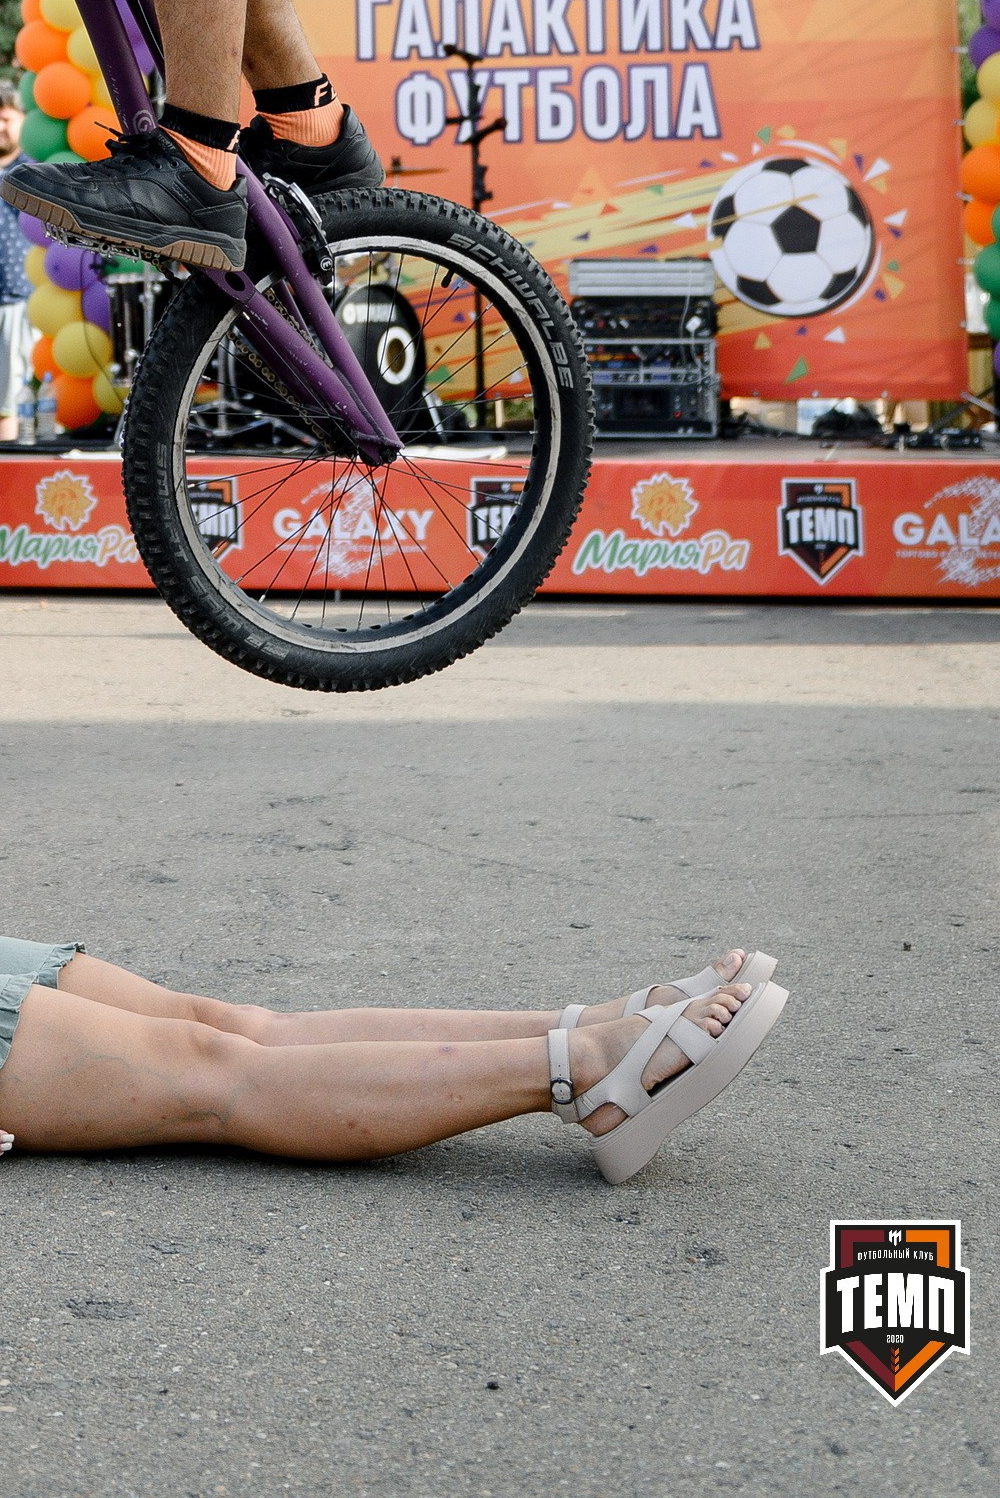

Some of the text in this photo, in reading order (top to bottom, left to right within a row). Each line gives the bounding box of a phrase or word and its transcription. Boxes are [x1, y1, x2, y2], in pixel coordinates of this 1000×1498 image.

[395, 63, 722, 146] ФУТБОЛА
[447, 233, 574, 389] SCHWALBE
[156, 443, 243, 631] SMART SAM
[273, 508, 434, 541] GALAXY
[786, 507, 855, 545] ТЕМП
[893, 512, 1000, 546] GALA
